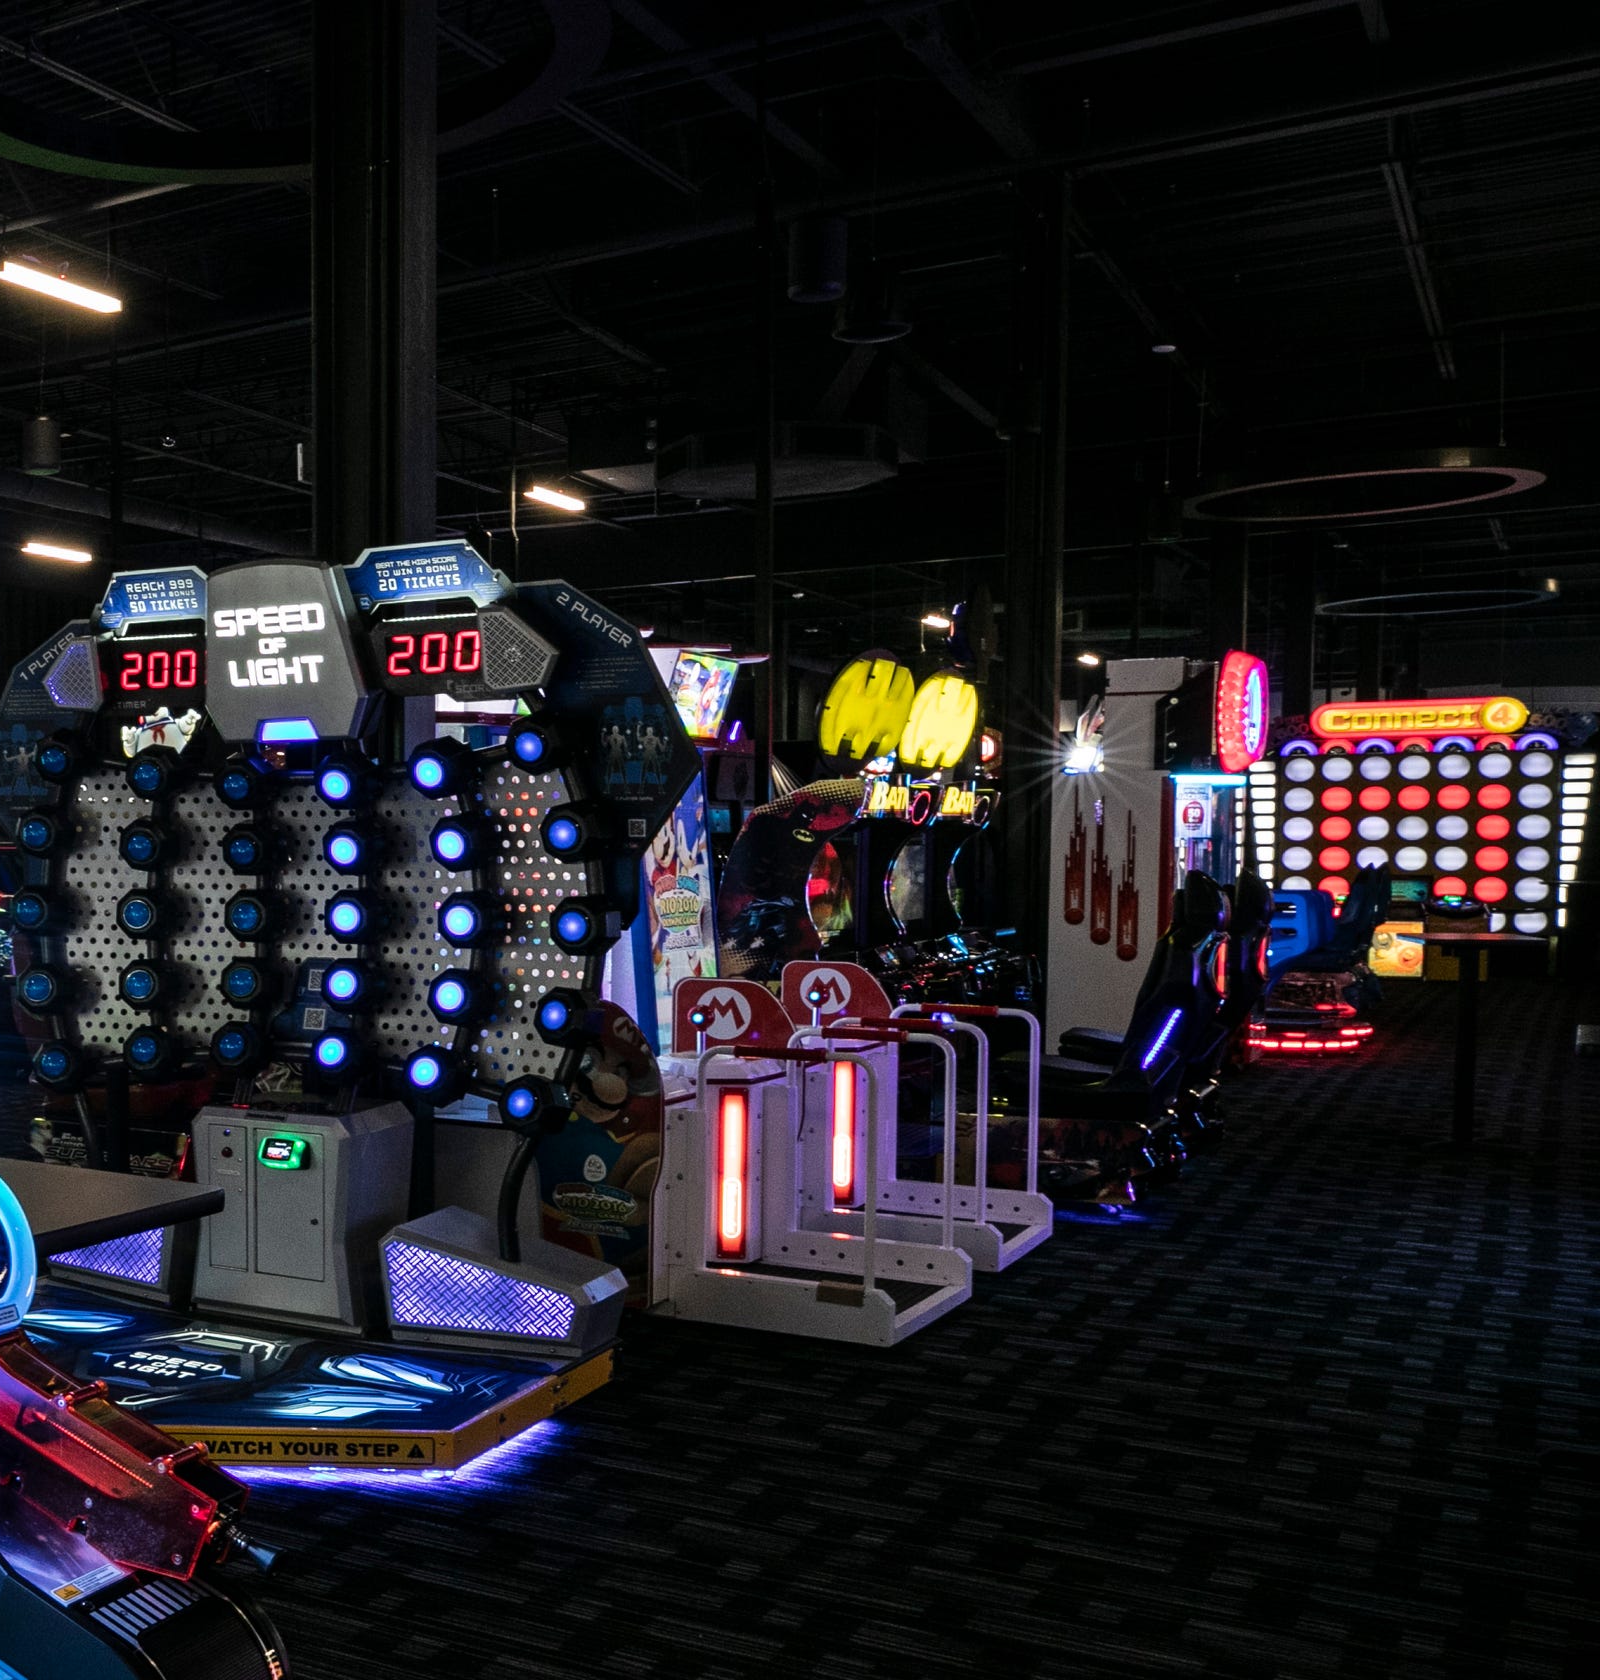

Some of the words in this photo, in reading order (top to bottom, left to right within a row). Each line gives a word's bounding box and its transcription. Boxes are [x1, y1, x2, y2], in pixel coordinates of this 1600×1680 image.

[375, 561, 394, 569] BEAT
[396, 559, 410, 567] THE
[412, 558, 431, 566] HIGH
[432, 555, 457, 564] SCORE
[393, 567, 413, 576] WIN
[426, 564, 459, 573] BONUS
[125, 581, 165, 593] REACH
[169, 579, 194, 589] 999
[378, 578, 398, 592] 20
[403, 574, 461, 590] TICKETS
[142, 592, 158, 600] WIN
[168, 589, 196, 598] BONUS
[129, 600, 147, 613] 50
[150, 598, 198, 611] TICKETS
[213, 603, 326, 637] SPEED
[556, 592, 570, 606] 2
[570, 601, 633, 648] PLAYER
[258, 637, 287, 655] OF
[387, 630, 481, 676] 200
[19, 671, 29, 681] 1
[121, 650, 197, 691] 200
[228, 655, 325, 688] LIGHT
[1326, 705, 1475, 732] Connect
[1489, 703, 1515, 726] 4
[661, 897, 676, 915] RIO
[676, 896, 699, 914] 2016
[113, 1361, 196, 1378] LIGHT
[129, 1351, 223, 1371] SPEED
[151, 1361, 180, 1369] OF
[203, 1440, 272, 1455] WATCH
[279, 1441, 339, 1457] YOUR
[345, 1443, 400, 1458] STEP
